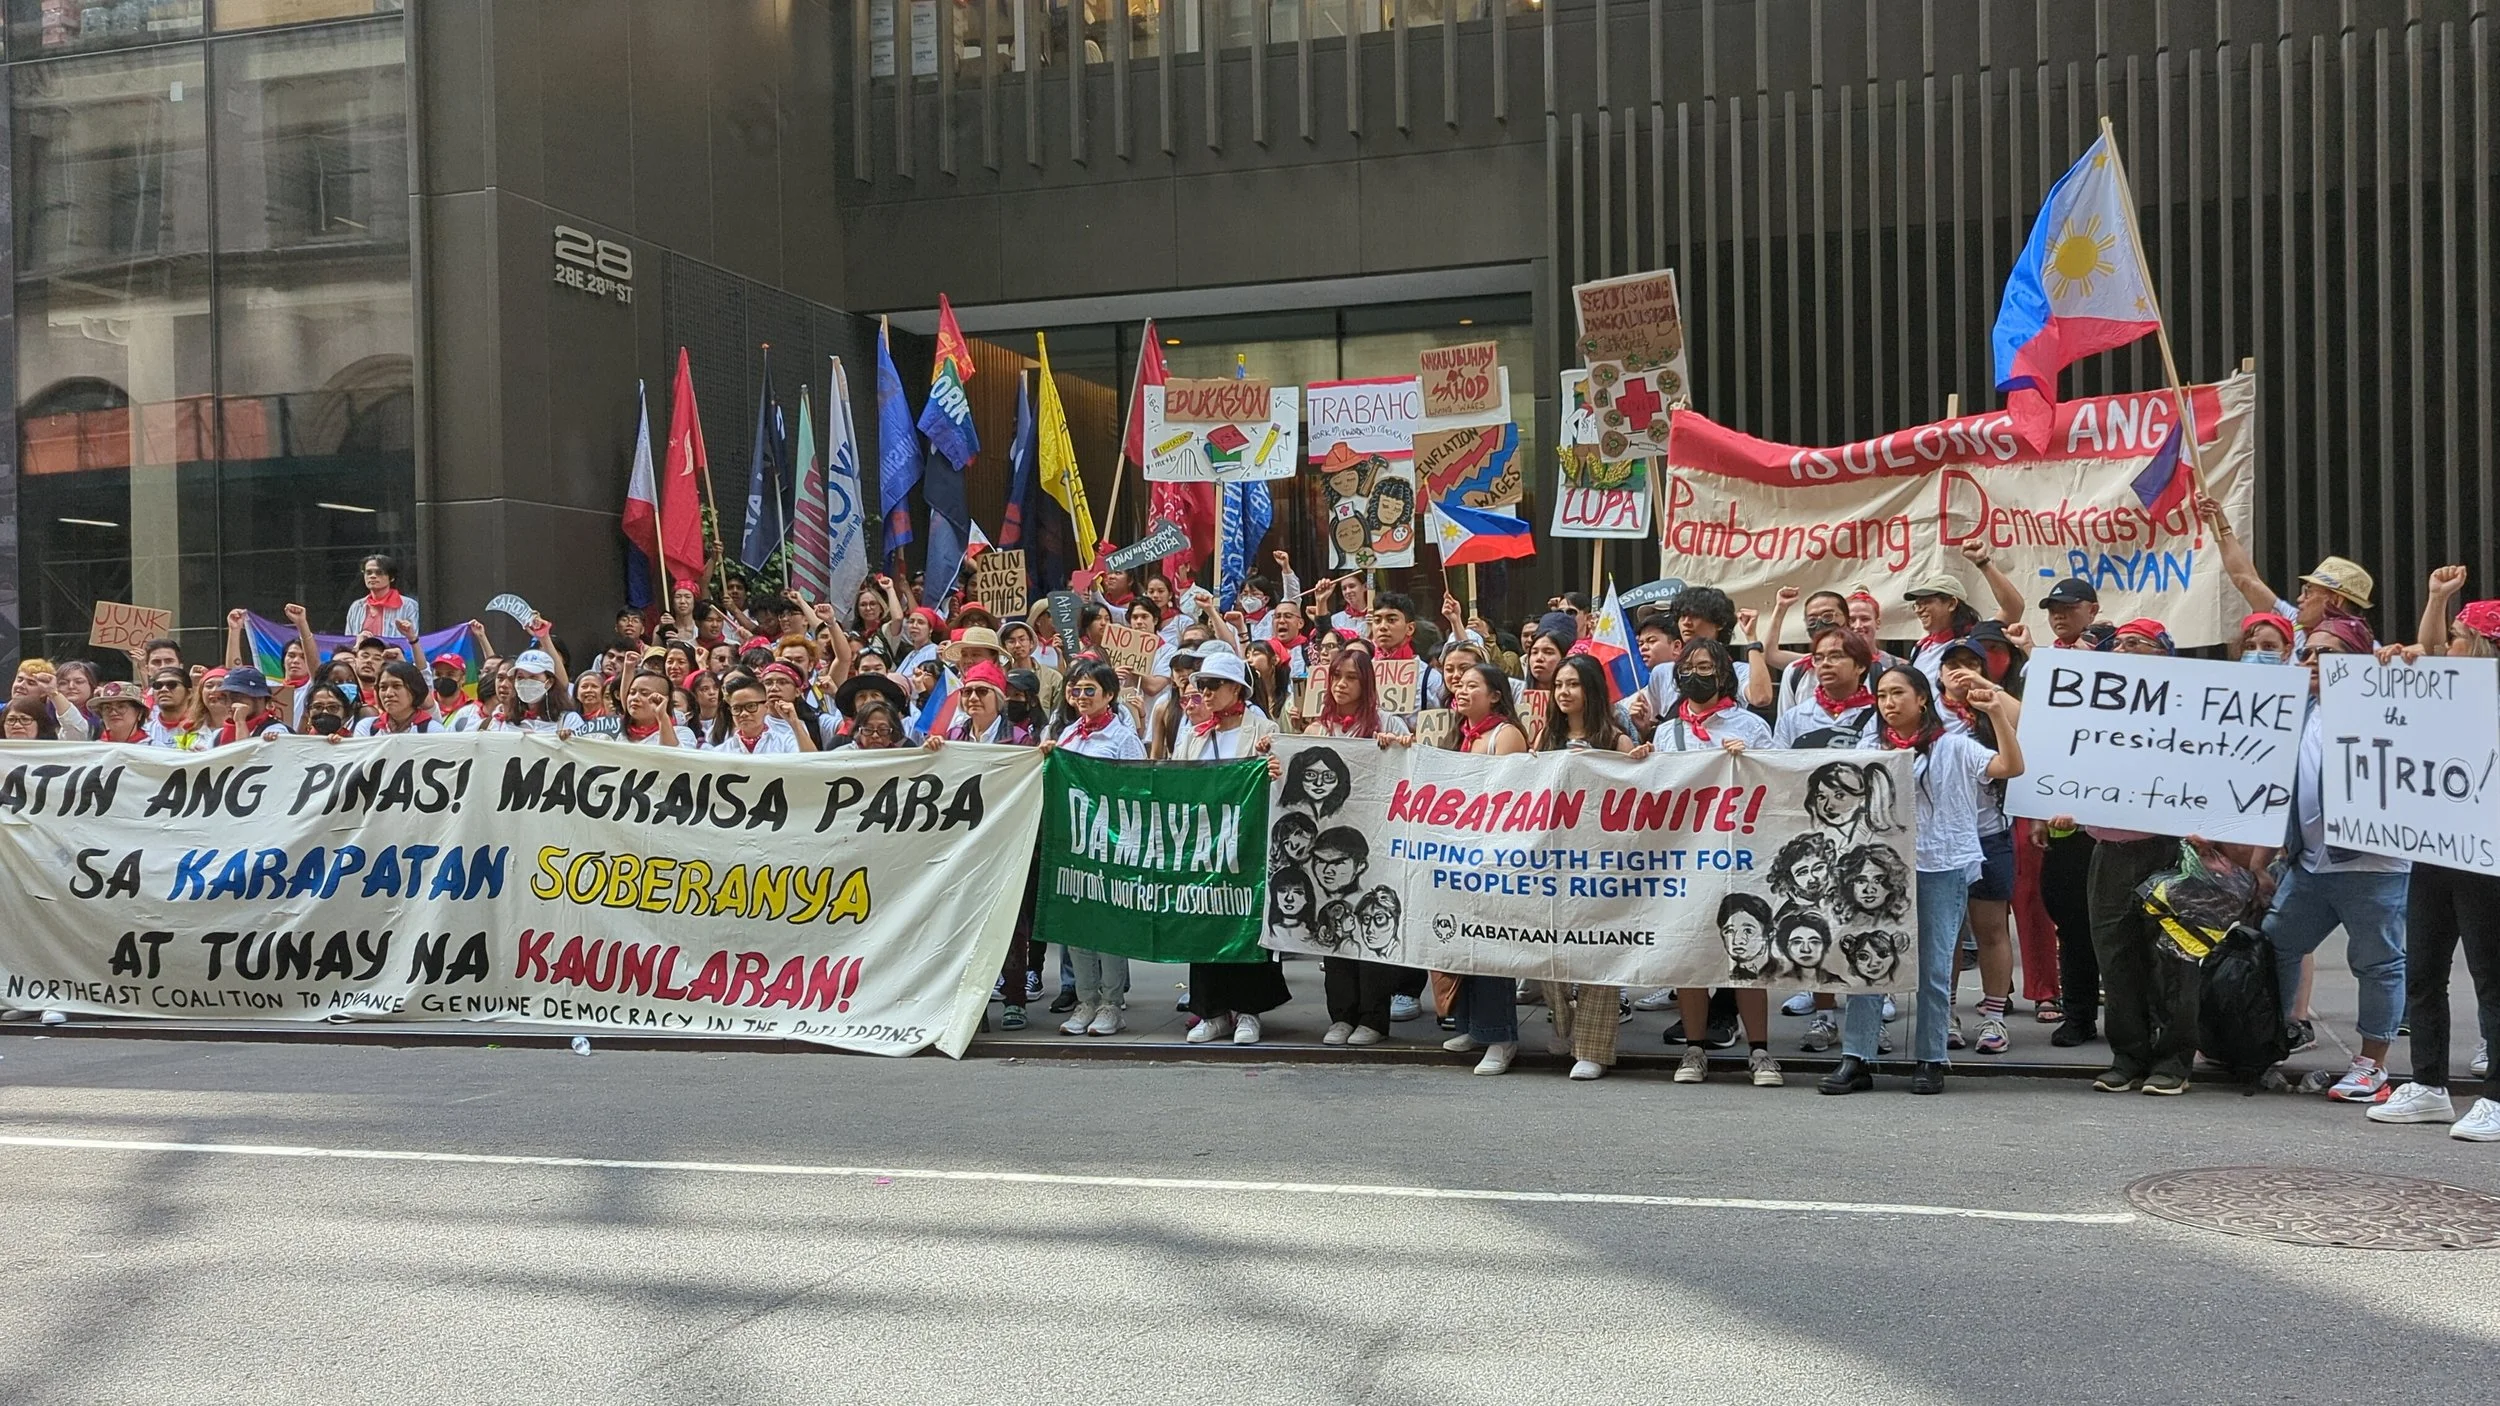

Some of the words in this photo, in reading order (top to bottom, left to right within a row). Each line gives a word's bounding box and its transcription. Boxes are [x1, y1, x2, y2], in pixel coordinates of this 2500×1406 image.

[554, 225, 633, 280] 28
[616, 284, 633, 304] ST
[930, 370, 970, 426] ORK
[1432, 375, 1489, 404] SAHOD
[1416, 427, 1479, 479] INFLATION
[1790, 415, 2017, 480] ISULONG
[2067, 397, 2168, 454] ANG
[1474, 465, 1521, 507] WAGES
[1562, 487, 1639, 529] LUPA
[1664, 476, 1911, 572] Pambansang
[980, 551, 1021, 573] ATIN
[1105, 549, 1133, 570] TUNAY
[1145, 551, 1157, 561] SA
[1154, 536, 1180, 555] LUPA
[979, 570, 1018, 589] ANG
[2067, 549, 2192, 593] BAYAN
[980, 586, 1026, 617] PINAS
[1619, 588, 1643, 605] ESYO
[96, 604, 169, 632] JUNK
[1106, 625, 1132, 648] NO
[1139, 634, 1156, 653] TO
[2048, 667, 2182, 716] BBM:
[2201, 686, 2296, 732] FAKE
[2361, 666, 2460, 700] SUPPORT
[574, 722, 595, 736] HOD
[2384, 706, 2408, 726] the
[2069, 727, 2276, 765] president!!!
[0, 764, 125, 817] ATIN
[145, 764, 272, 819] ANG
[288, 757, 473, 818] PINAS!
[497, 756, 789, 833] MAGKAISA
[814, 773, 985, 833] PARA
[1386, 779, 1586, 834] KABATAAN
[1600, 784, 1768, 835] UNITE!
[2141, 775, 2208, 810] fake
[2228, 778, 2291, 814] VP
[1068, 787, 1241, 874] DAMAYAN
[2342, 816, 2494, 868] MANDAMUS
[1390, 838, 1484, 867] FILIPINO
[1492, 848, 1589, 871] YOUTH
[1600, 849, 1687, 871] FIGHT
[1696, 849, 1754, 871] FOR
[69, 847, 143, 899] SA
[167, 843, 510, 901] KARAPATAN
[531, 846, 871, 925] SOBERANYA
[1056, 865, 1107, 904] migrant
[1111, 875, 1174, 913] workers
[1175, 880, 1253, 916] association
[1433, 869, 1557, 897] PEOPLE'S
[1569, 876, 1687, 898] RIGHTS!
[1460, 923, 1558, 945] KABATAAN
[1563, 929, 1655, 946] ALLIANCE
[107, 930, 175, 980] AT
[201, 930, 393, 982] TUNAY
[406, 931, 489, 985] NA
[515, 928, 865, 1015] KAUNLARAN!
[7, 974, 141, 1006] NORTHEAST
[152, 985, 283, 1010] COALITION
[298, 991, 321, 1007] TO
[329, 989, 406, 1014] ADVANCE
[421, 993, 530, 1018] GENUINE
[544, 999, 693, 1029] DEMOCRACY
[707, 1015, 733, 1031] IN
[743, 1018, 778, 1032] THE
